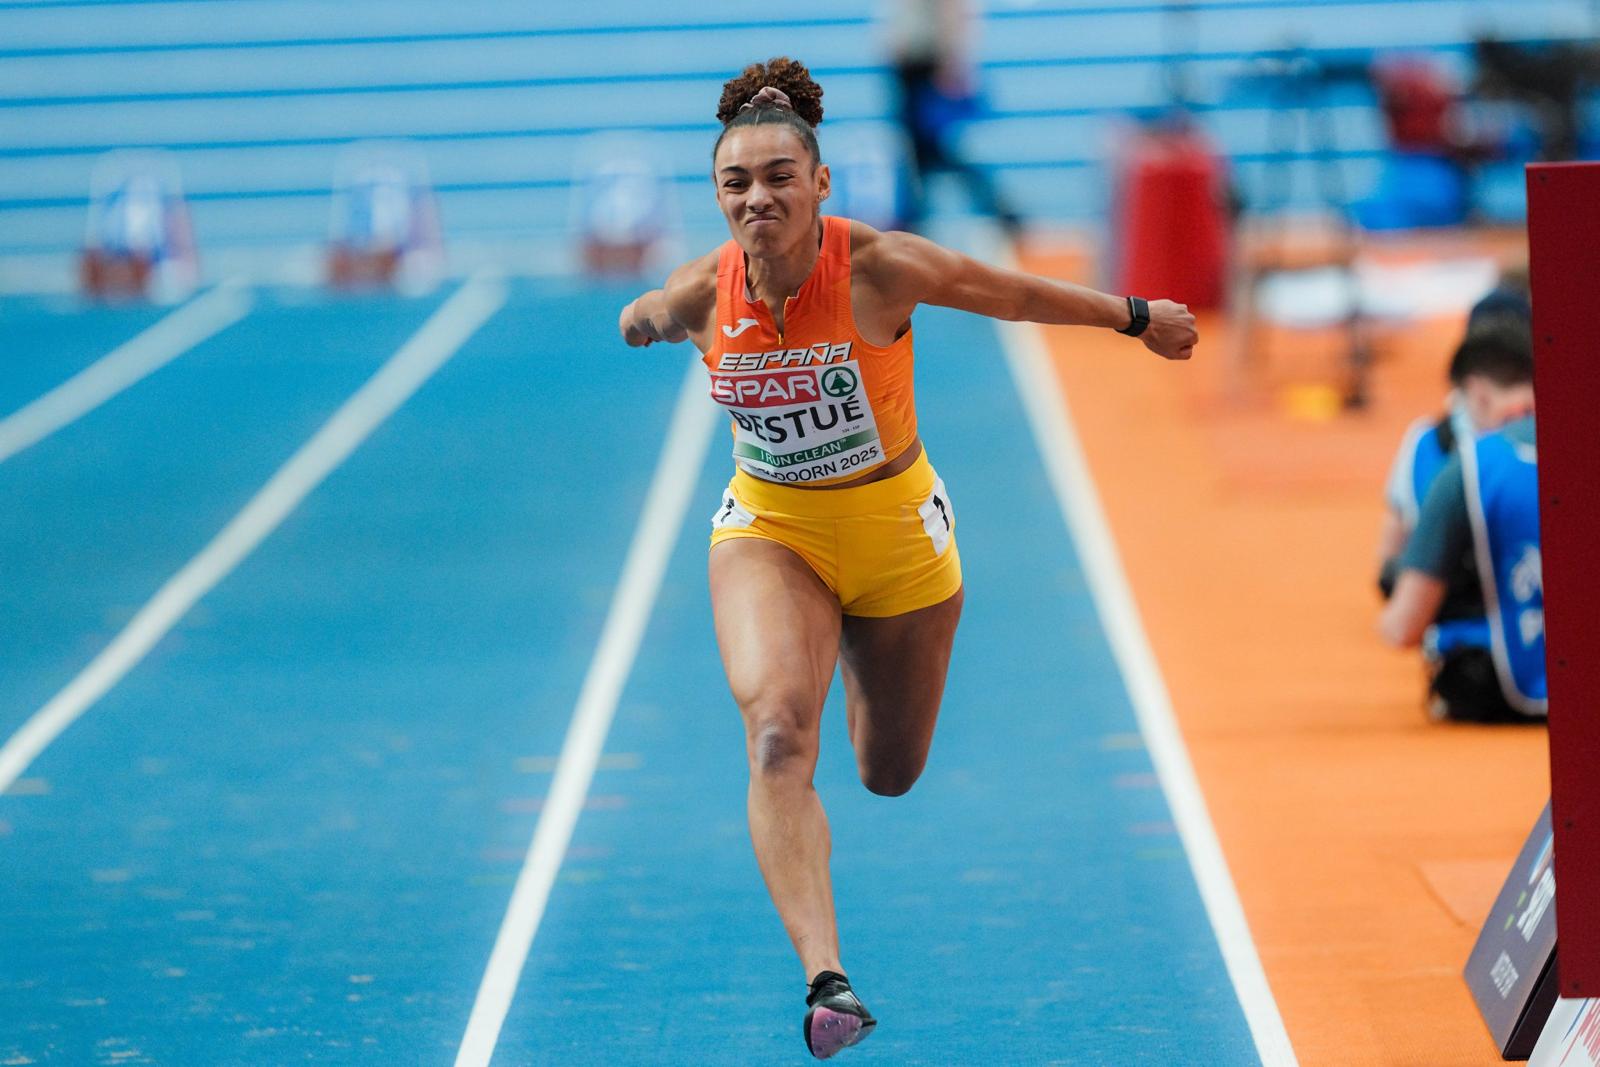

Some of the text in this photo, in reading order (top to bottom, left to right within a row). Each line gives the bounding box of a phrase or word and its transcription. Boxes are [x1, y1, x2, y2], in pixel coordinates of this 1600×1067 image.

[718, 341, 853, 371] ESPAÑA
[714, 374, 817, 404] SPAR
[728, 394, 864, 443] BESTUÉ
[765, 454, 792, 466] RUN
[840, 446, 880, 471] 2025
